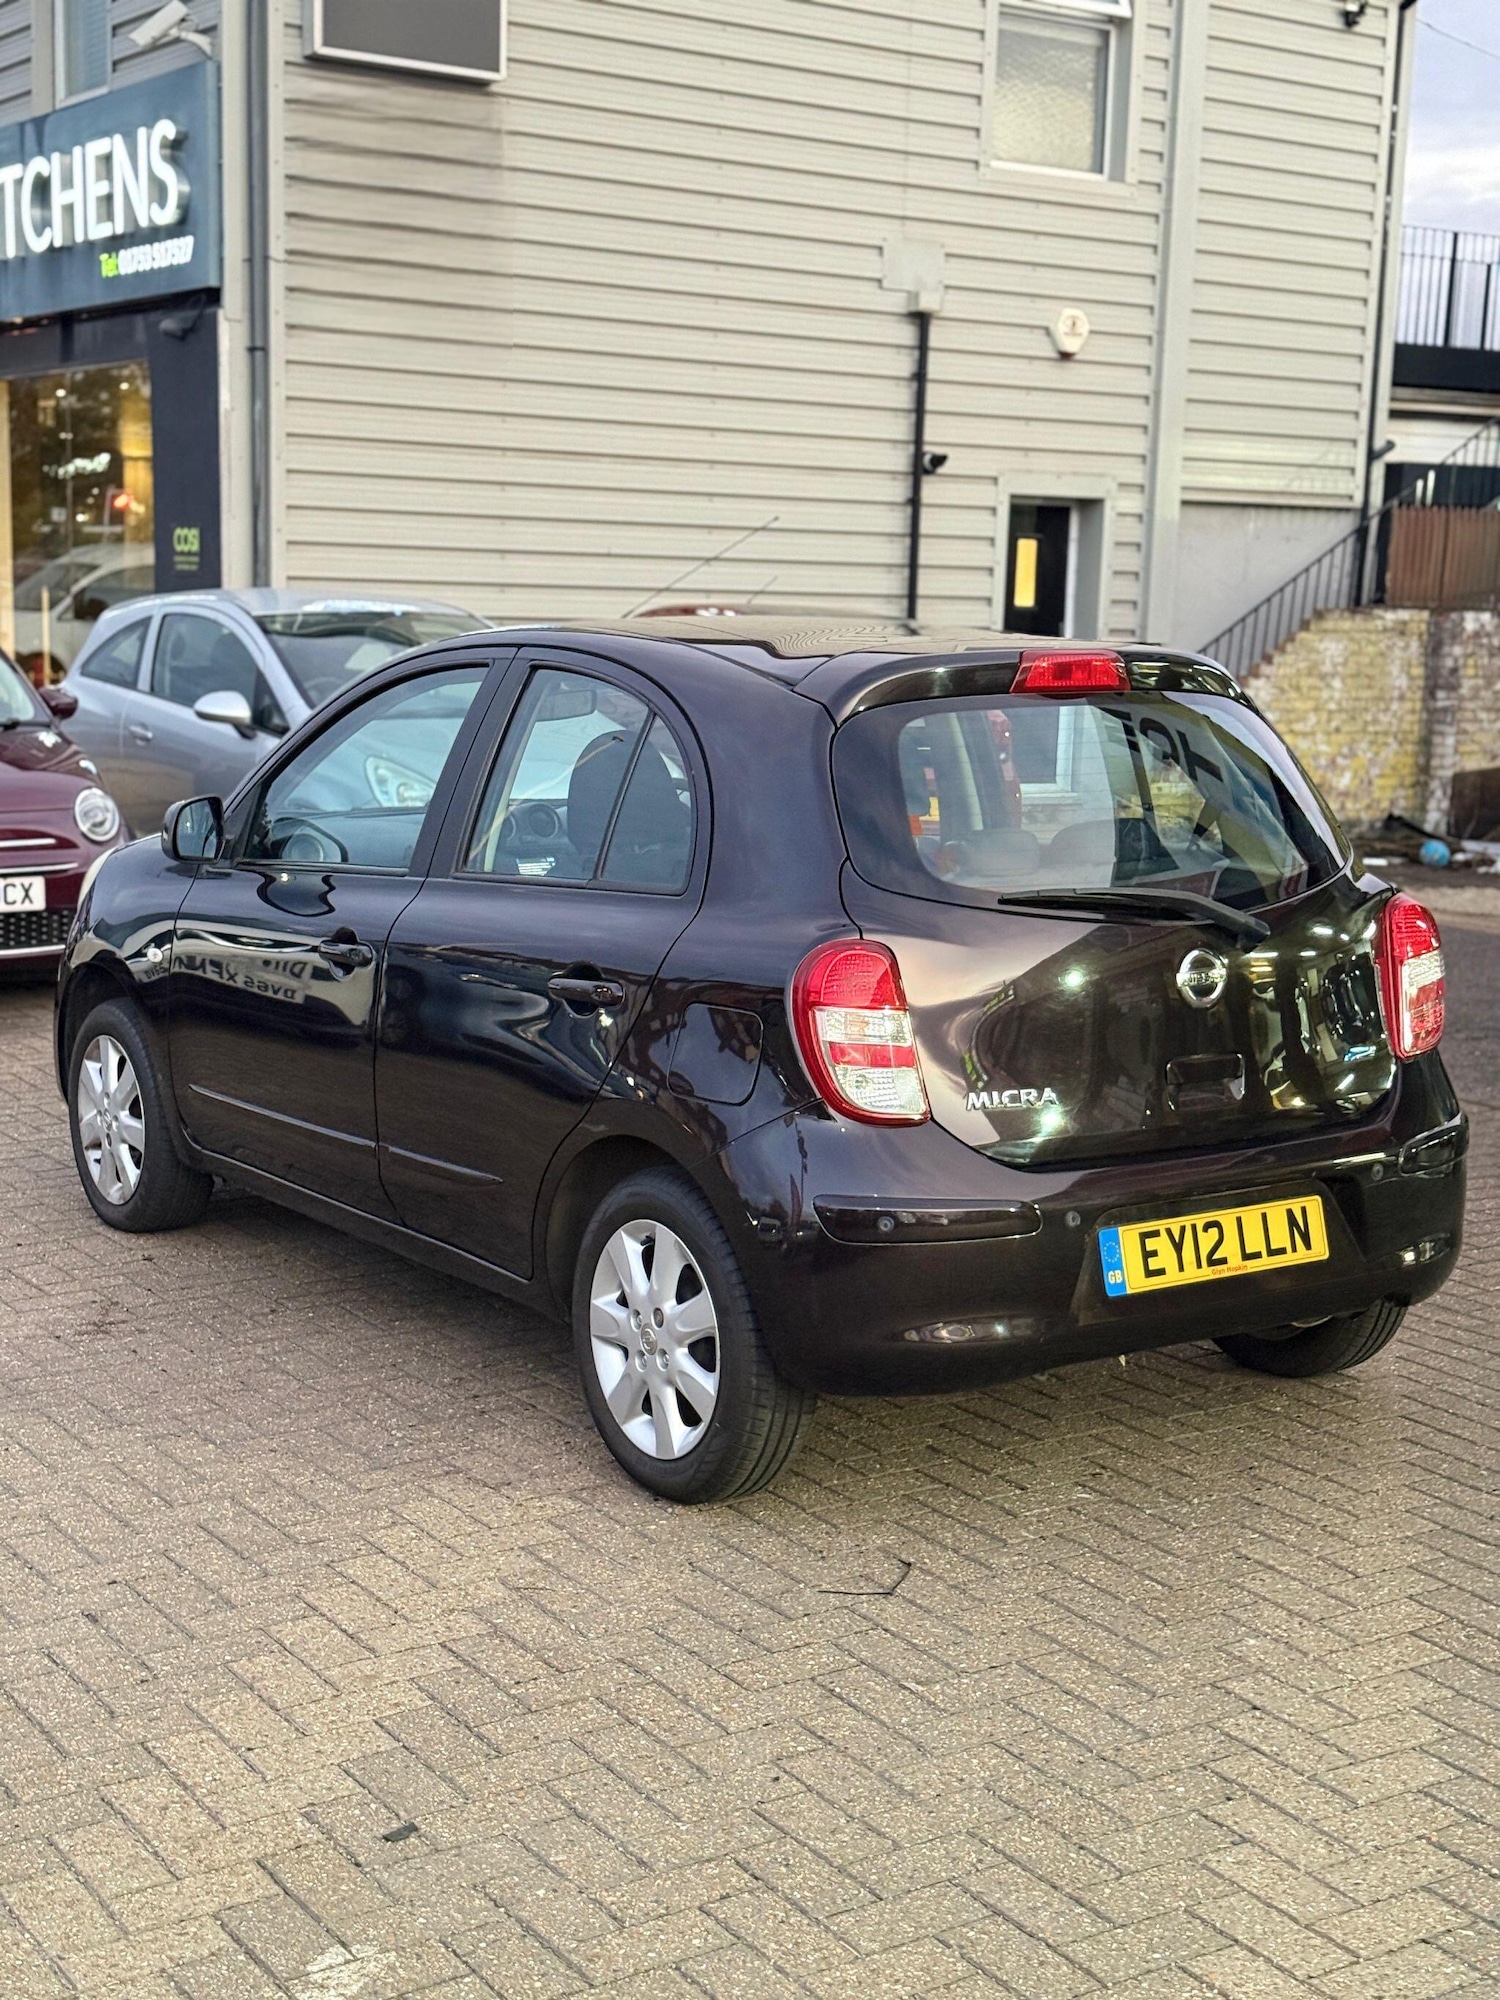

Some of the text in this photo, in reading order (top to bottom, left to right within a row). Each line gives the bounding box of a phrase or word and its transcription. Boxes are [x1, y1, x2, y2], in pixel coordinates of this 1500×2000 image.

[0, 118, 179, 259] TCHENS
[3, 882, 34, 905] CX
[966, 1087, 1059, 1110] MICRA
[1138, 1205, 1313, 1279] EY12 LLN
[1107, 1269, 1123, 1285] GB
[1211, 1266, 1226, 1277] Glyn
